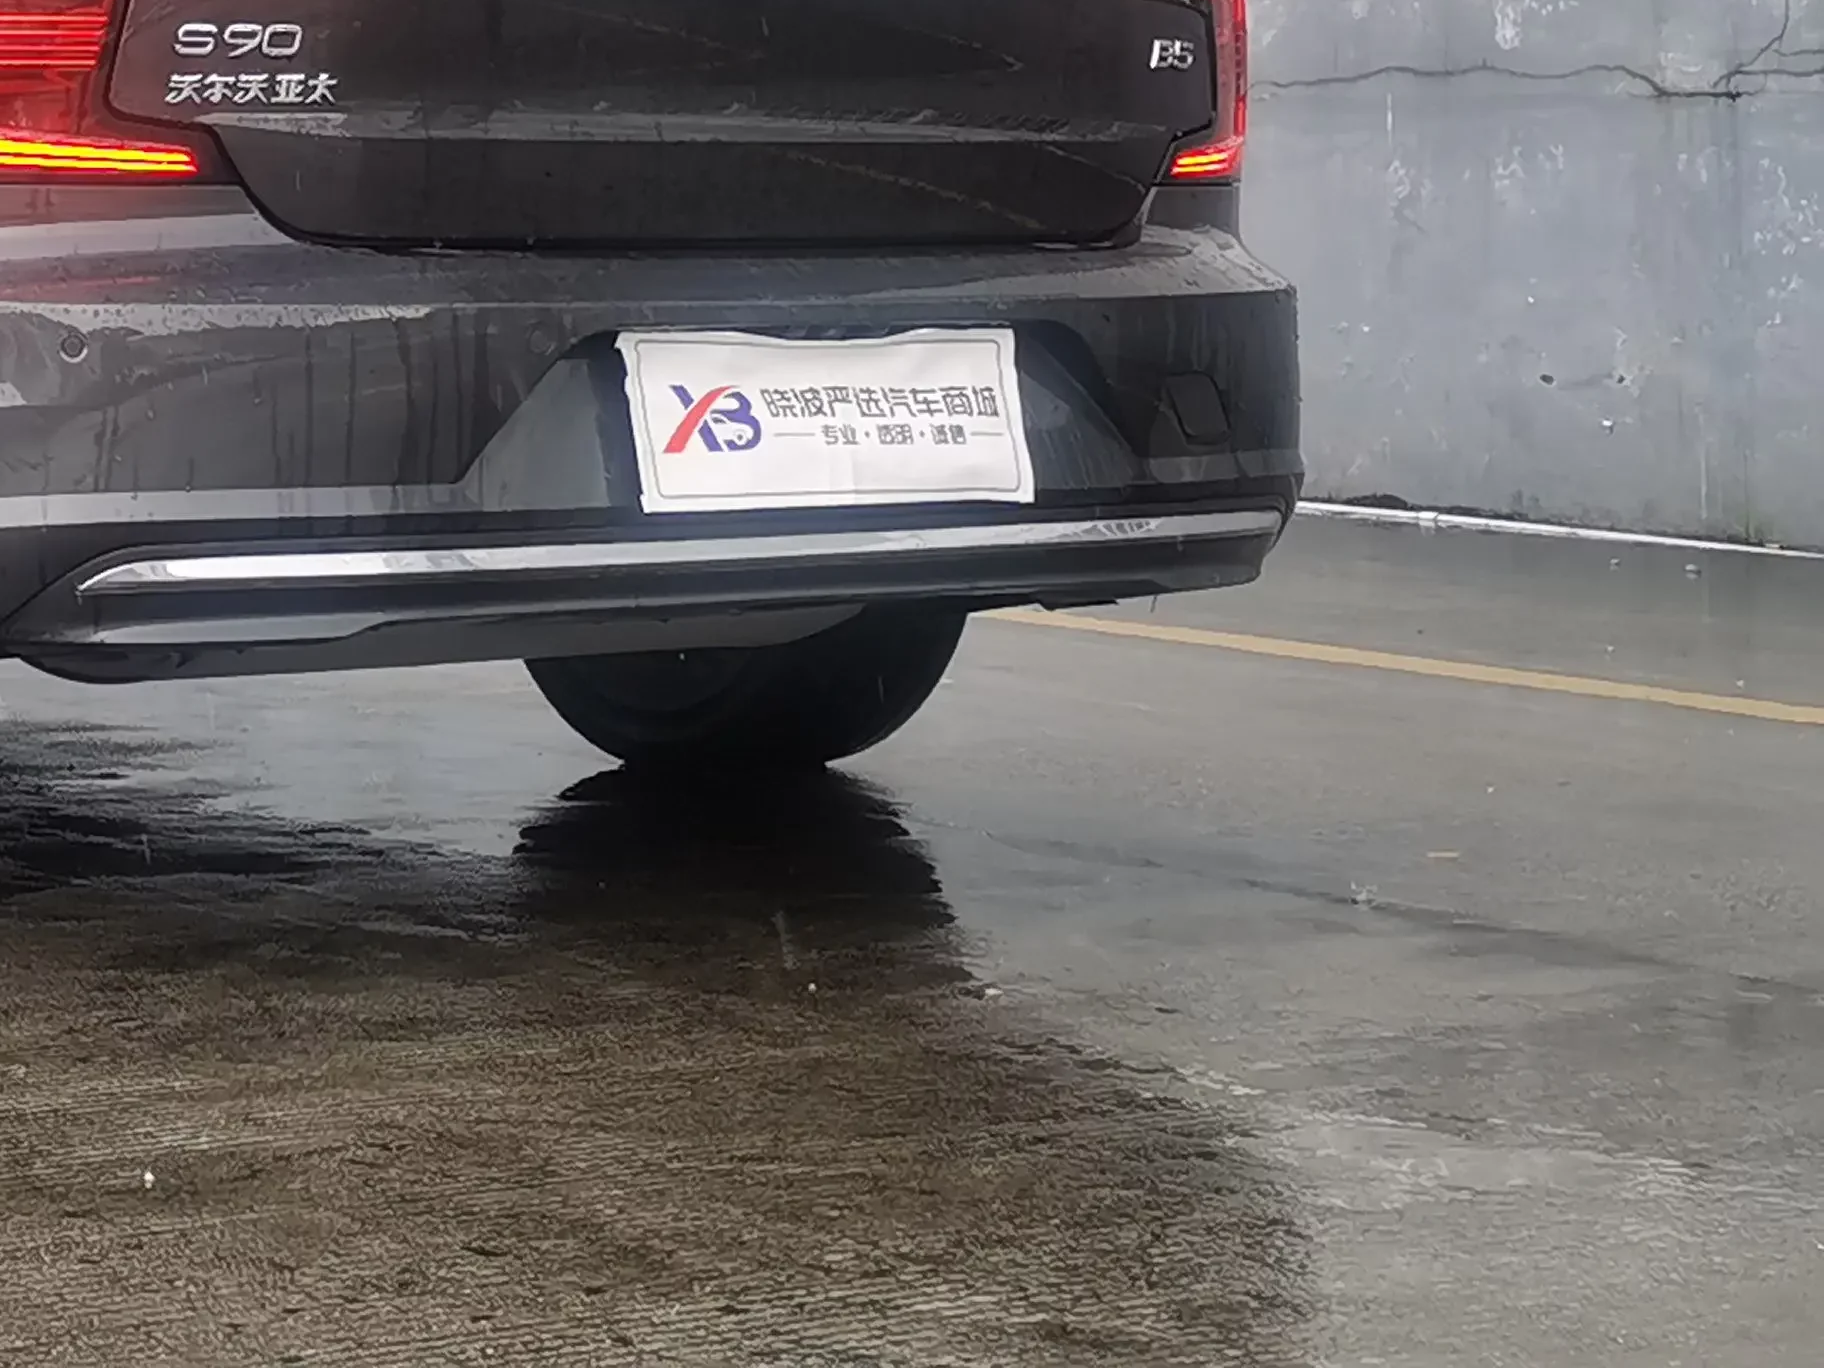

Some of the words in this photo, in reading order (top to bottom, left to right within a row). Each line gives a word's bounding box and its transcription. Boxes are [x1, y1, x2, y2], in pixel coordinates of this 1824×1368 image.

[174, 23, 303, 57] S90
[1149, 39, 1195, 69] B5
[164, 73, 338, 105] 沃尔沃亚太
